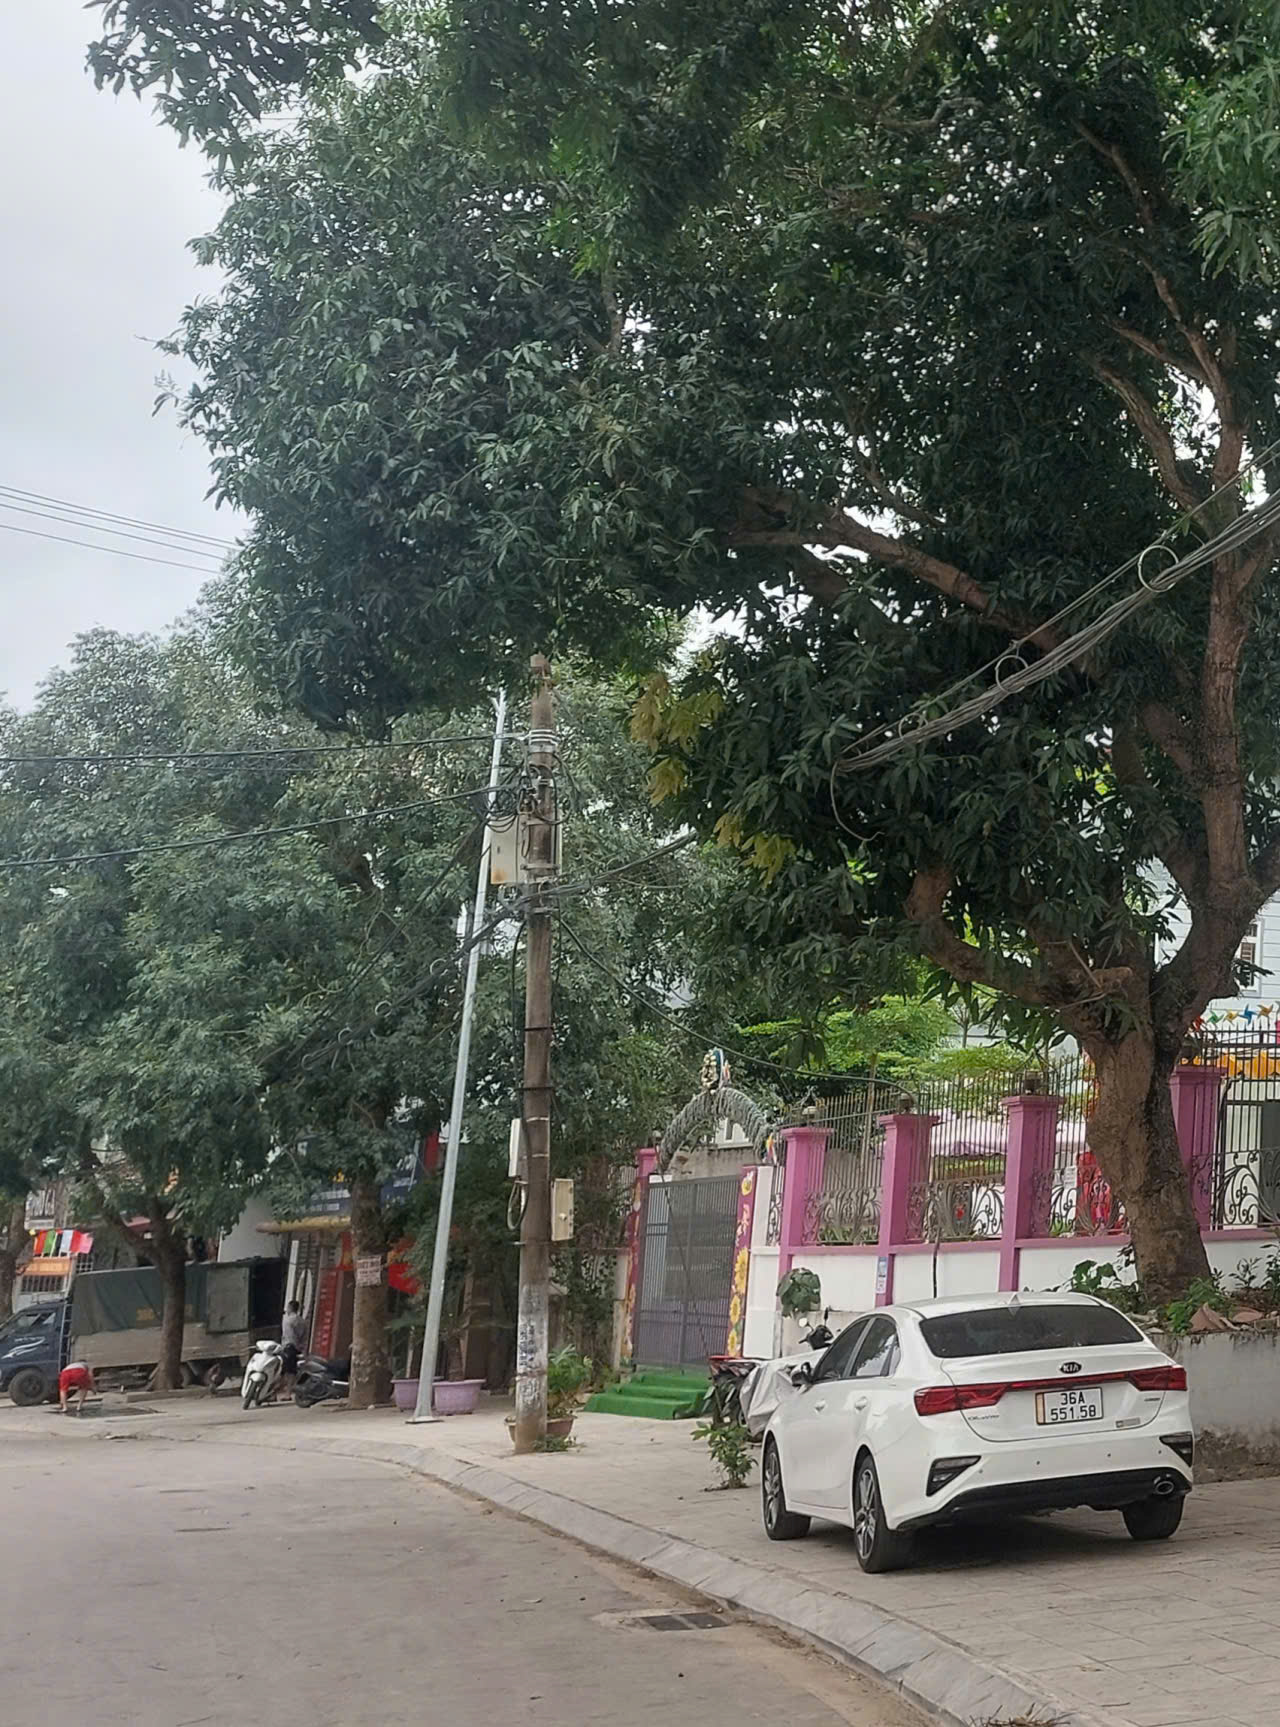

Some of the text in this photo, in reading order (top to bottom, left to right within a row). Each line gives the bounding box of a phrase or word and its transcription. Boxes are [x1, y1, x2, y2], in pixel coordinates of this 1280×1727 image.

[1062, 1363, 1081, 1373] KIA
[1060, 1392, 1086, 1405] 36A
[1050, 1404, 1097, 1422] 551.58
